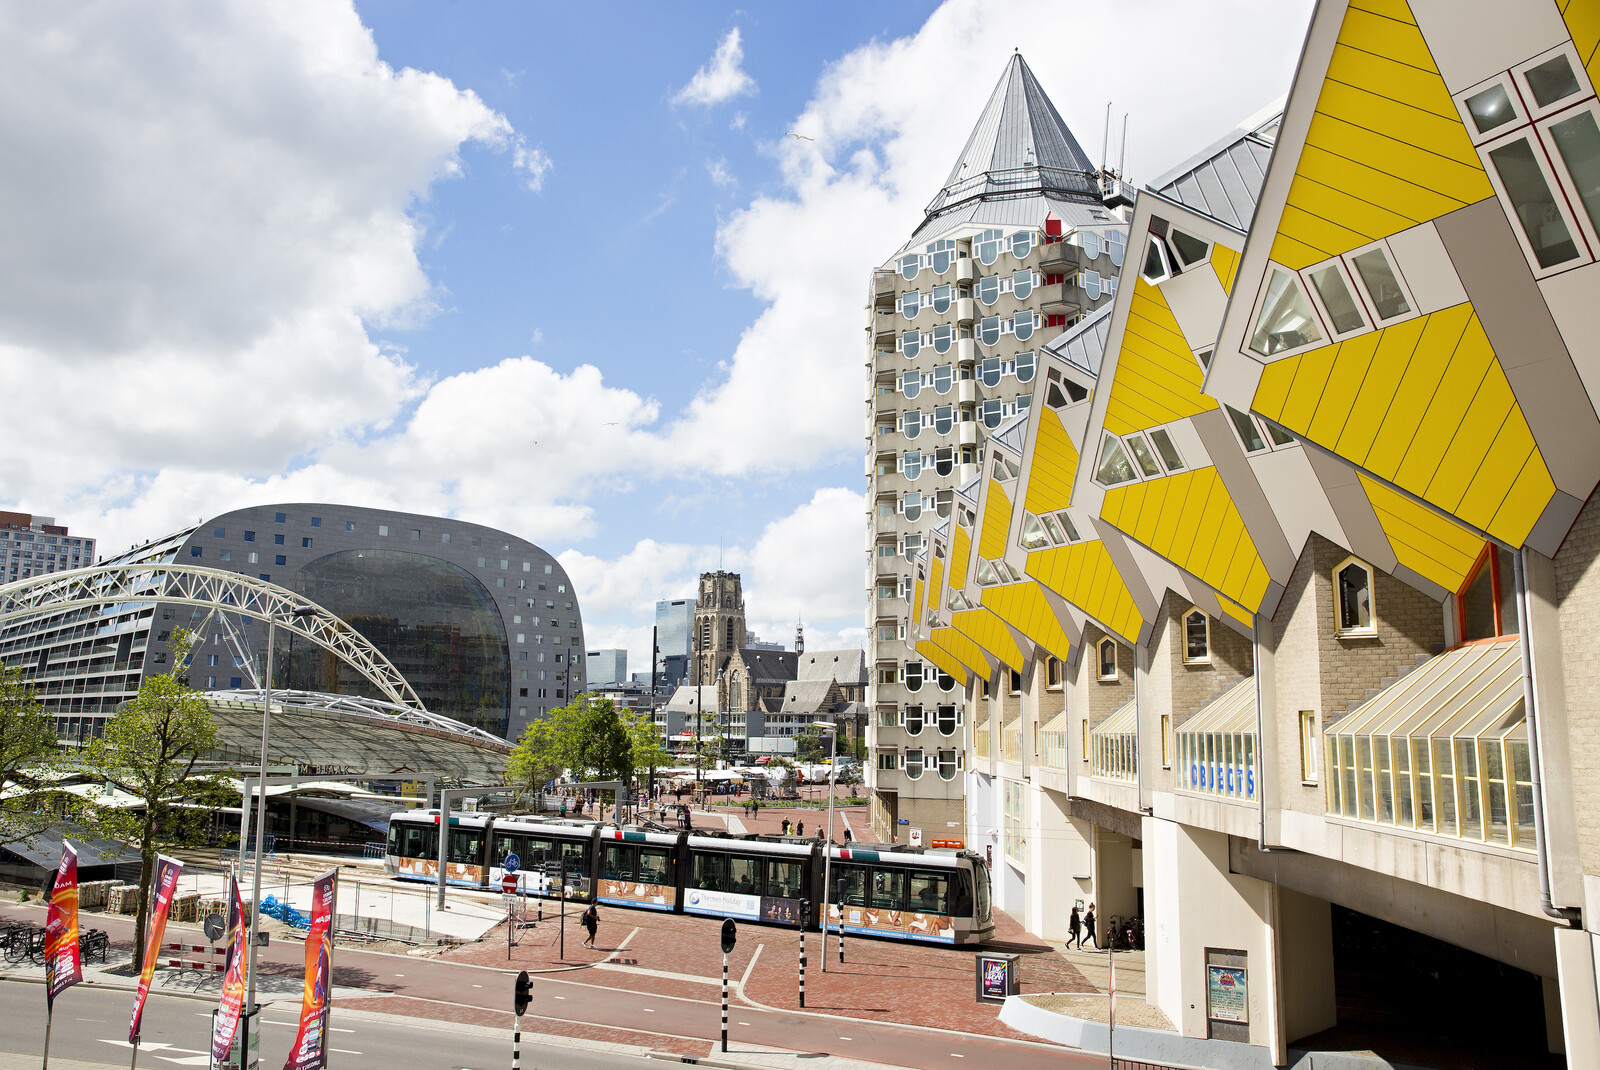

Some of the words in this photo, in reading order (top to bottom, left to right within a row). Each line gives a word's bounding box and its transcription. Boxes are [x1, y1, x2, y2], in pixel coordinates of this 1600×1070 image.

[316, 764, 350, 775] BLAAK
[1191, 764, 1254, 795] OBJECTS
[701, 893, 722, 903] Thermen
[722, 896, 741, 907] Holiday
